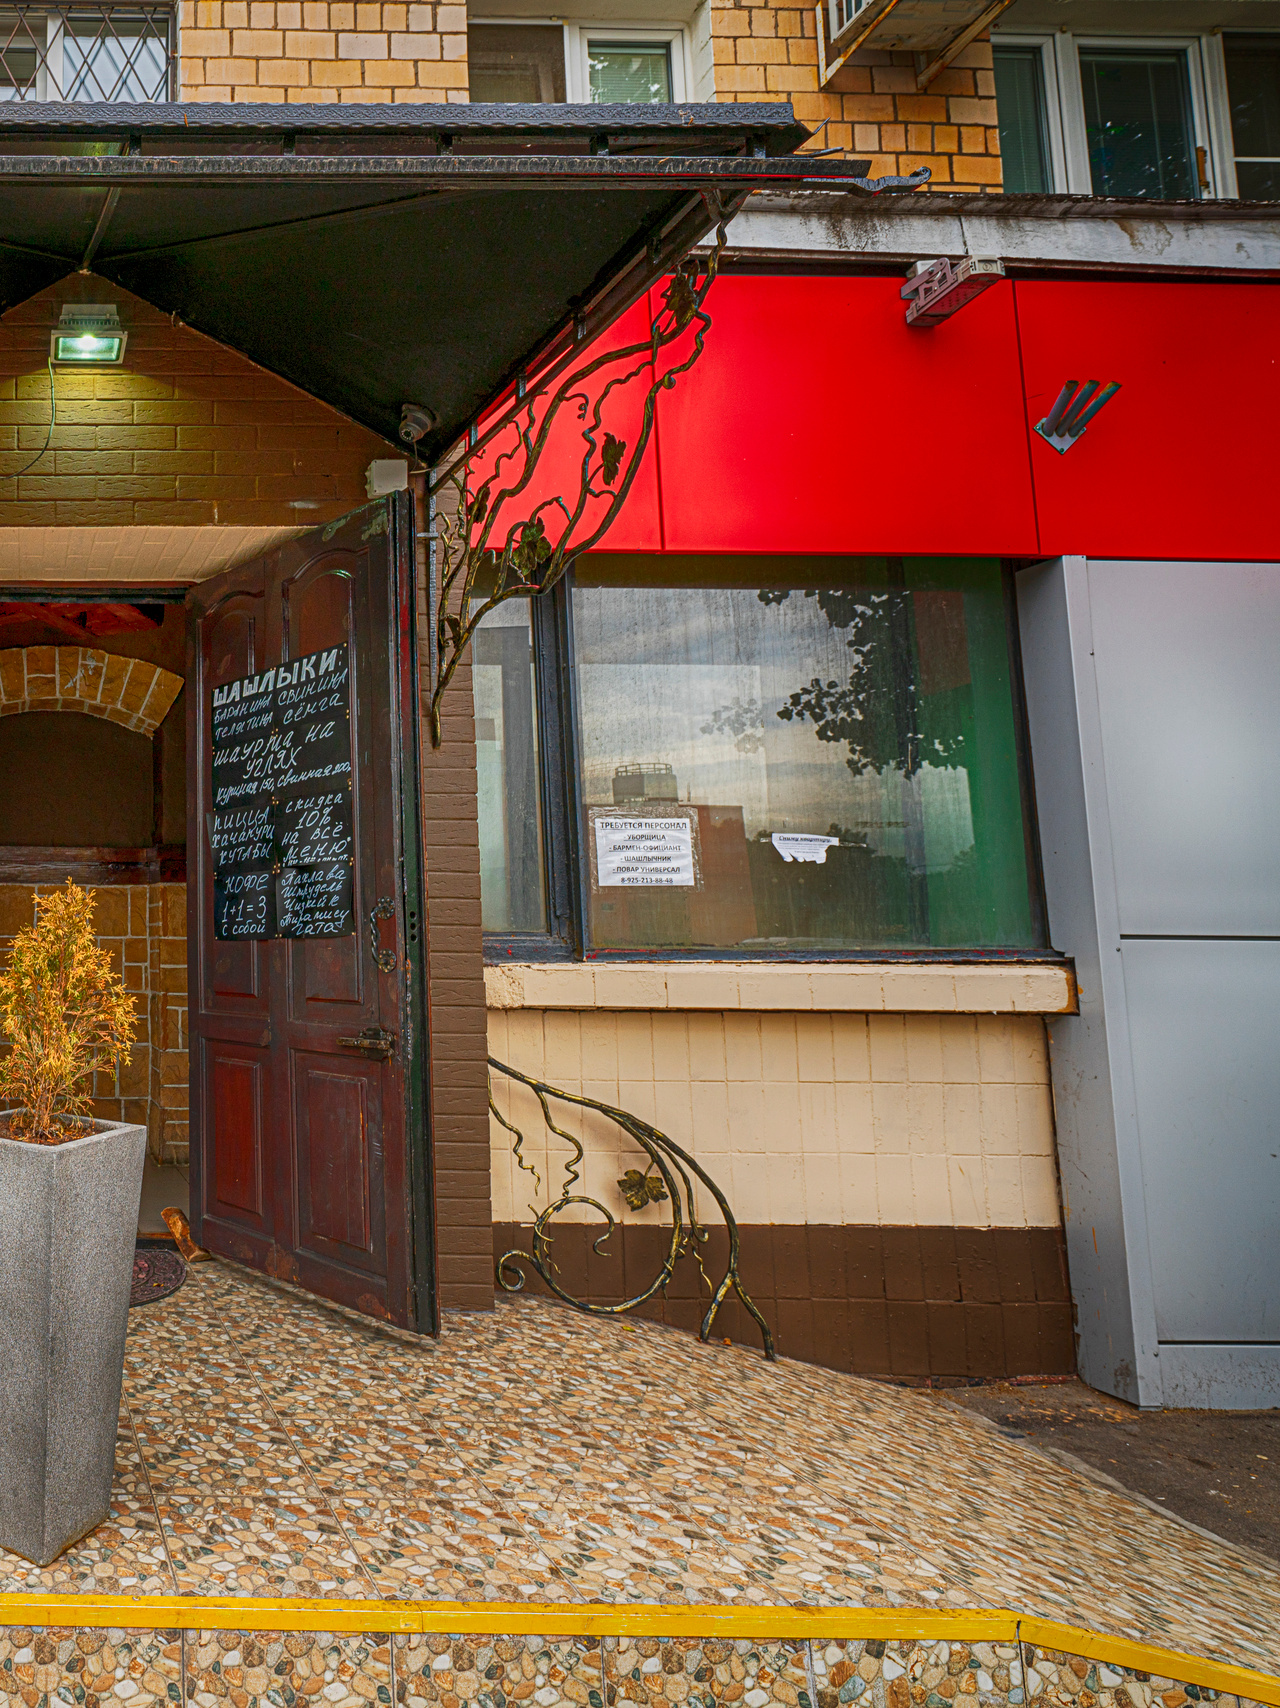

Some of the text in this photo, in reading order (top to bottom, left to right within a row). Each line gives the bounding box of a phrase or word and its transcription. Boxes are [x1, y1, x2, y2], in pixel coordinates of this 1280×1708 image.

[213, 648, 343, 707] ШАШЛЫКИ:
[278, 668, 348, 706] СВИНИНА
[295, 806, 333, 830] 10%
